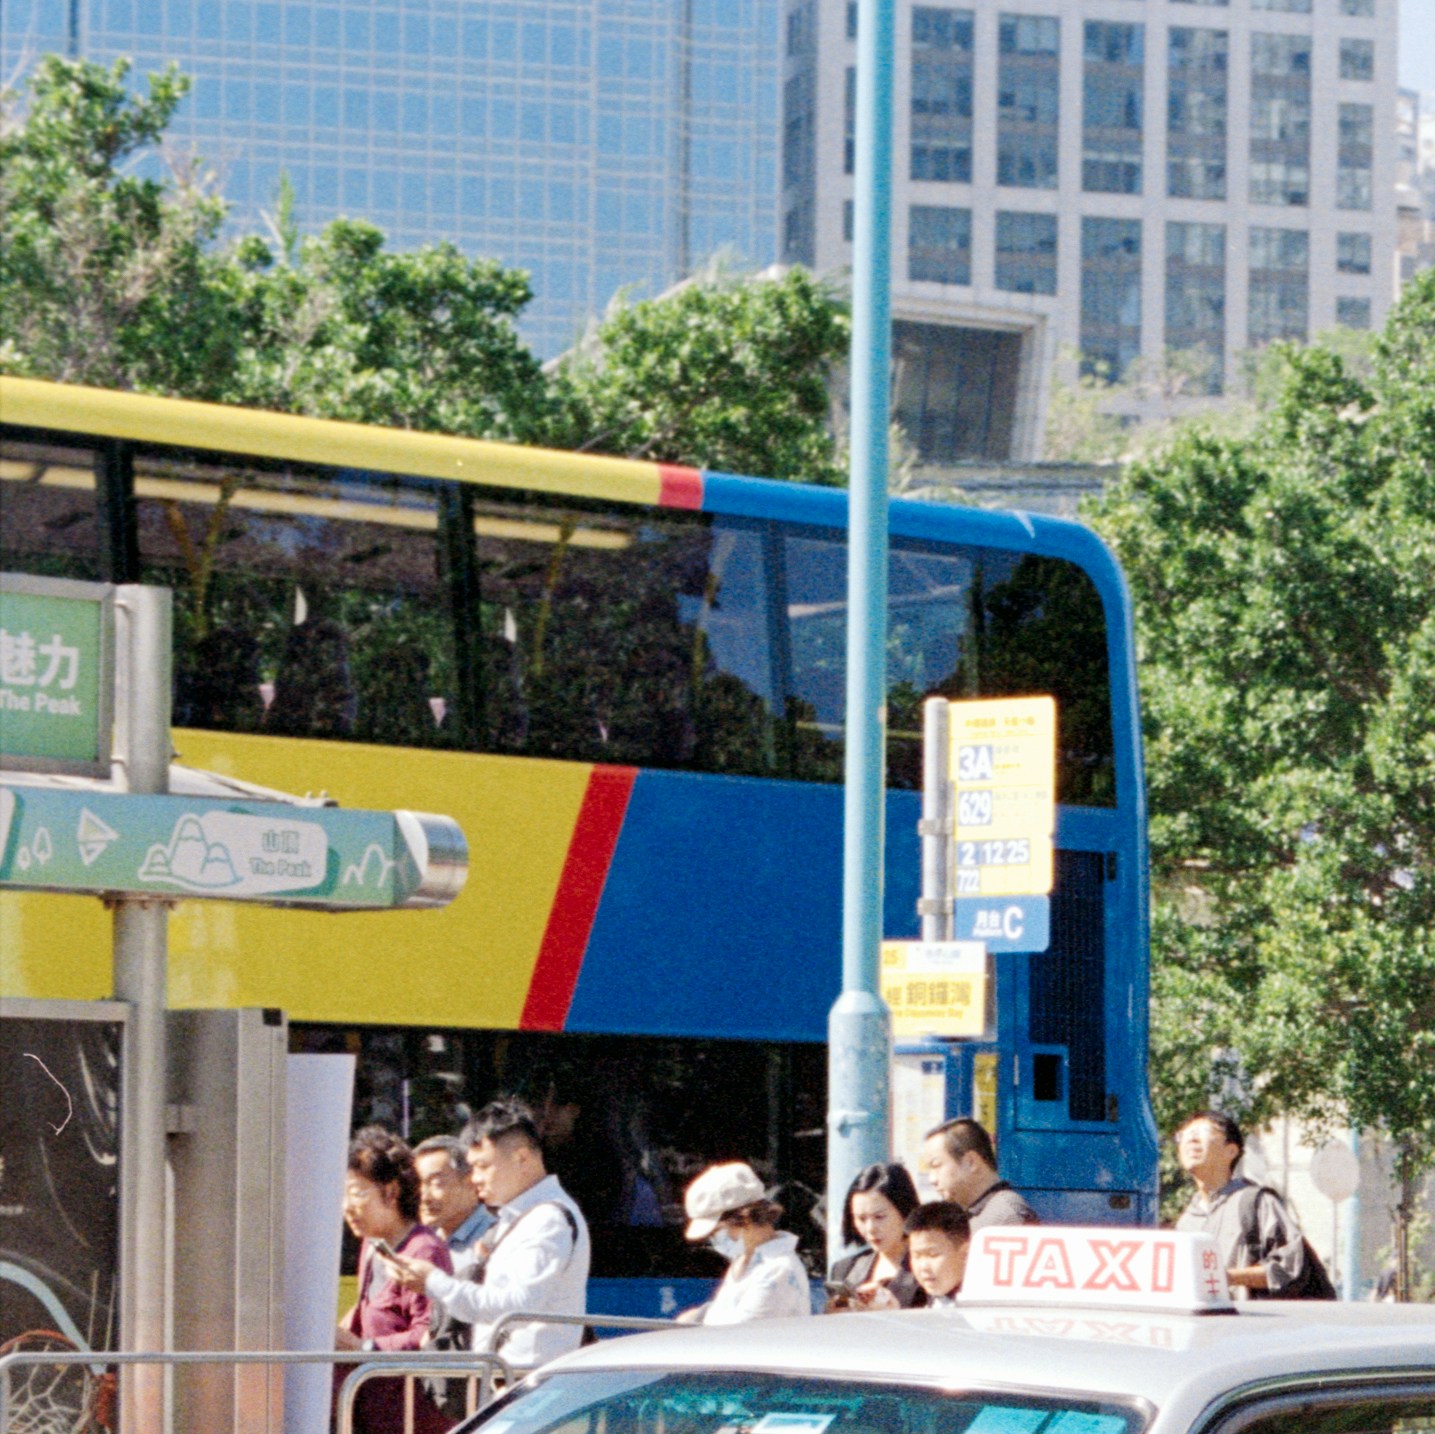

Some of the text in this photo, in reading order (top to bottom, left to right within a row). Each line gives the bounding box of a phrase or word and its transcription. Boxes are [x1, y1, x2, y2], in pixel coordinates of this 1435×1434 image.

[35, 692, 80, 715] Peak
[959, 744, 992, 780] 3A
[249, 857, 312, 877] The Peak
[960, 840, 1029, 866] 2 12 25
[1003, 905, 1024, 939] C
[983, 1236, 1175, 1293] TAXI
[1202, 1249, 1220, 1296] 的士
